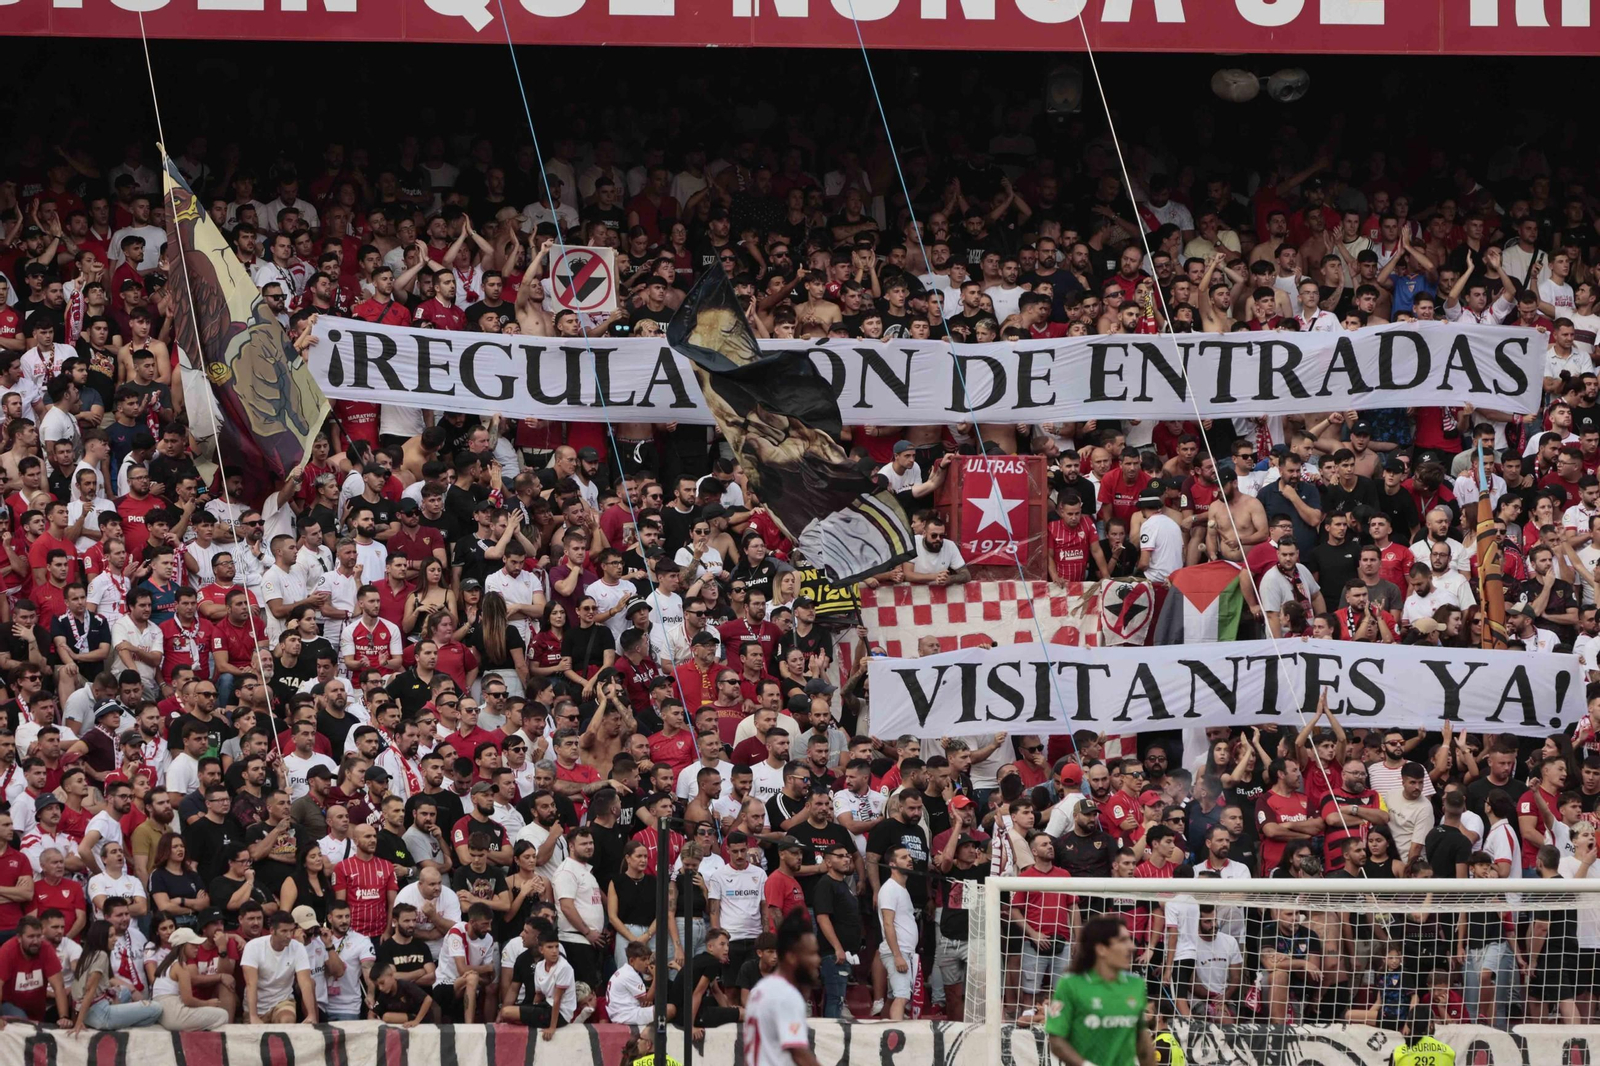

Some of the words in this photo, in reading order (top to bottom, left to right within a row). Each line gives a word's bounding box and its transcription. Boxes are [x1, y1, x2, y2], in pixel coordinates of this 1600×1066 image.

[327, 329, 919, 409] ¡REGULAÓN
[944, 349, 1056, 412] DE
[1083, 331, 1529, 403] ENTRADAS
[966, 459, 1025, 474] ULTRAS
[969, 539, 1019, 553] 1975
[891, 652, 1385, 727] VISITANTES
[1420, 660, 1571, 729] YA!
[1401, 1042, 1448, 1054] SEGURIDAD
[1414, 1056, 1436, 1066] 292
